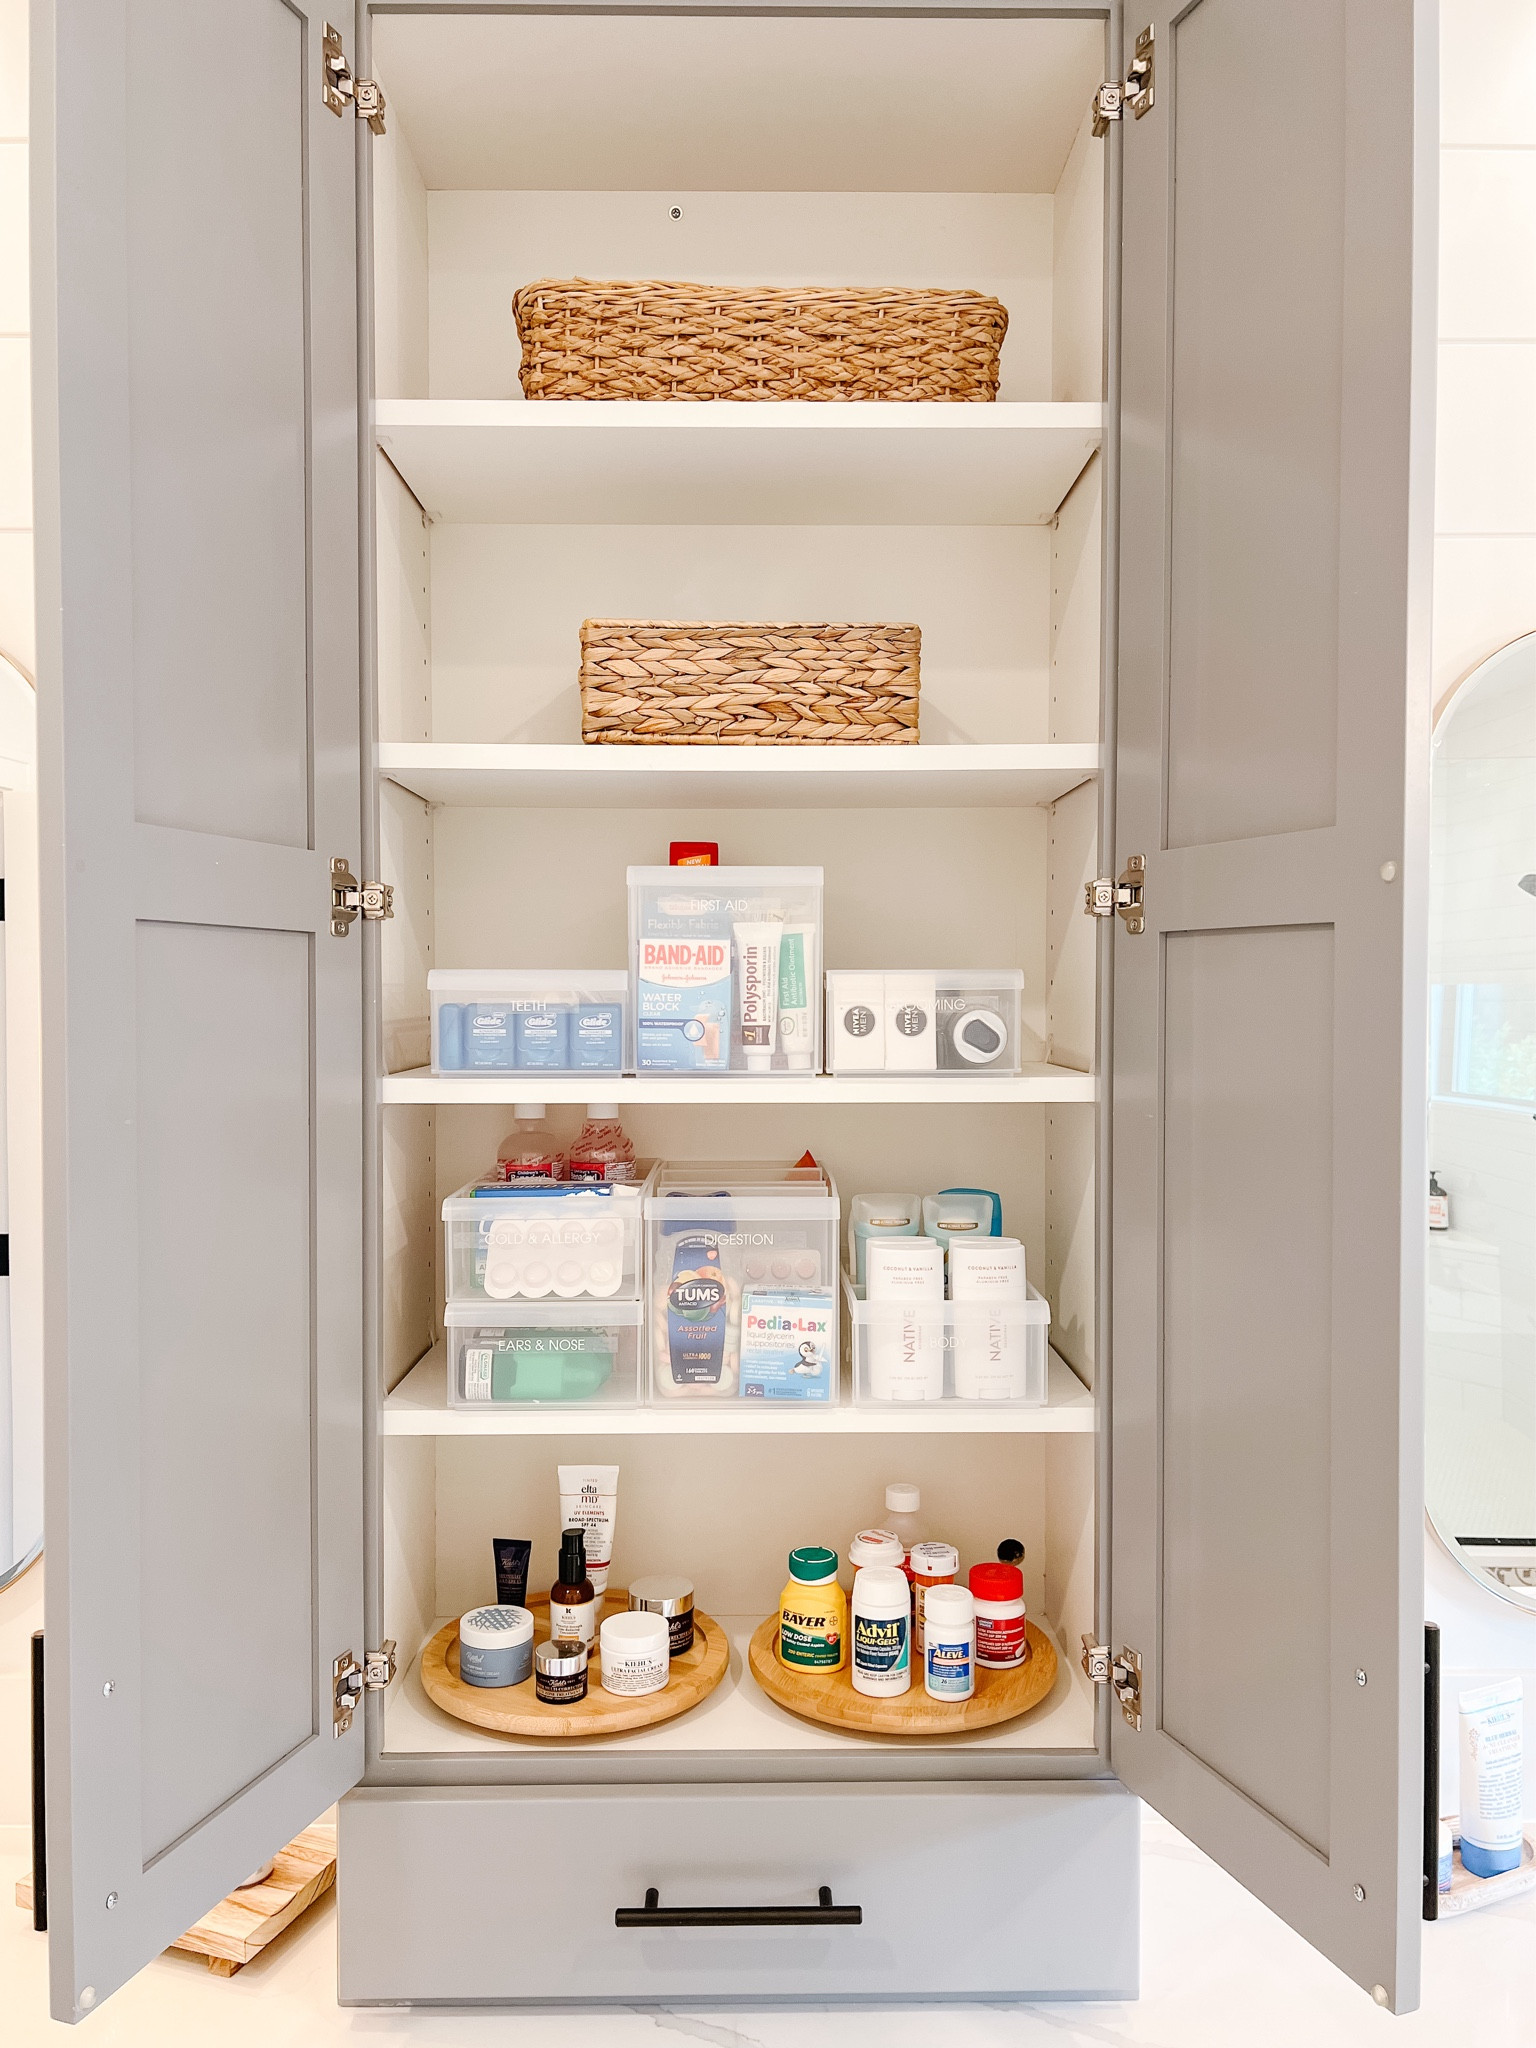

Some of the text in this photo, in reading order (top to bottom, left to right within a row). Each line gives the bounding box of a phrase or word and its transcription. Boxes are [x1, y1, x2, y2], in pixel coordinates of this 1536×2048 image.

[686, 857, 702, 866] NEW
[690, 899, 748, 912] FIRST AID
[644, 944, 725, 966] BAND-AID
[787, 938, 798, 1005] Antibiotic Ointment
[743, 946, 762, 1023] Polysporin
[781, 977, 789, 989] Aid
[642, 993, 682, 1003] WATER
[511, 1000, 547, 1012] TEETH
[642, 1002, 680, 1012] BLOCK
[476, 1017, 503, 1026] Glide
[527, 1018, 555, 1027] Glide
[582, 1018, 608, 1027] Glide
[852, 1008, 860, 1035] NIVEA
[859, 1010, 867, 1032] MEN
[904, 1008, 912, 1034] NIVEA
[911, 1010, 919, 1032] MEN
[641, 1059, 652, 1067] 30
[484, 1232, 601, 1245] COLD & ALLERGY
[704, 1233, 774, 1246] DIGESTION
[675, 1288, 720, 1301] TUMS
[677, 1324, 718, 1332] Assorted
[687, 1332, 707, 1340] Fruit
[746, 1331, 795, 1341] liquid glycerin
[903, 1309, 916, 1363] NATIVE
[989, 1309, 1002, 1362] NATIVE
[498, 1339, 586, 1352] EARS & NOSE
[746, 1340, 796, 1350] suppositories
[929, 1336, 968, 1348] BODY
[581, 1484, 597, 1494] elta
[782, 1610, 827, 1628] BAYER
[856, 1620, 899, 1638] Advil
[793, 1633, 813, 1643] DOSE
[856, 1633, 899, 1646] LIQUI-GELS
[933, 1649, 964, 1660] ALEVE
